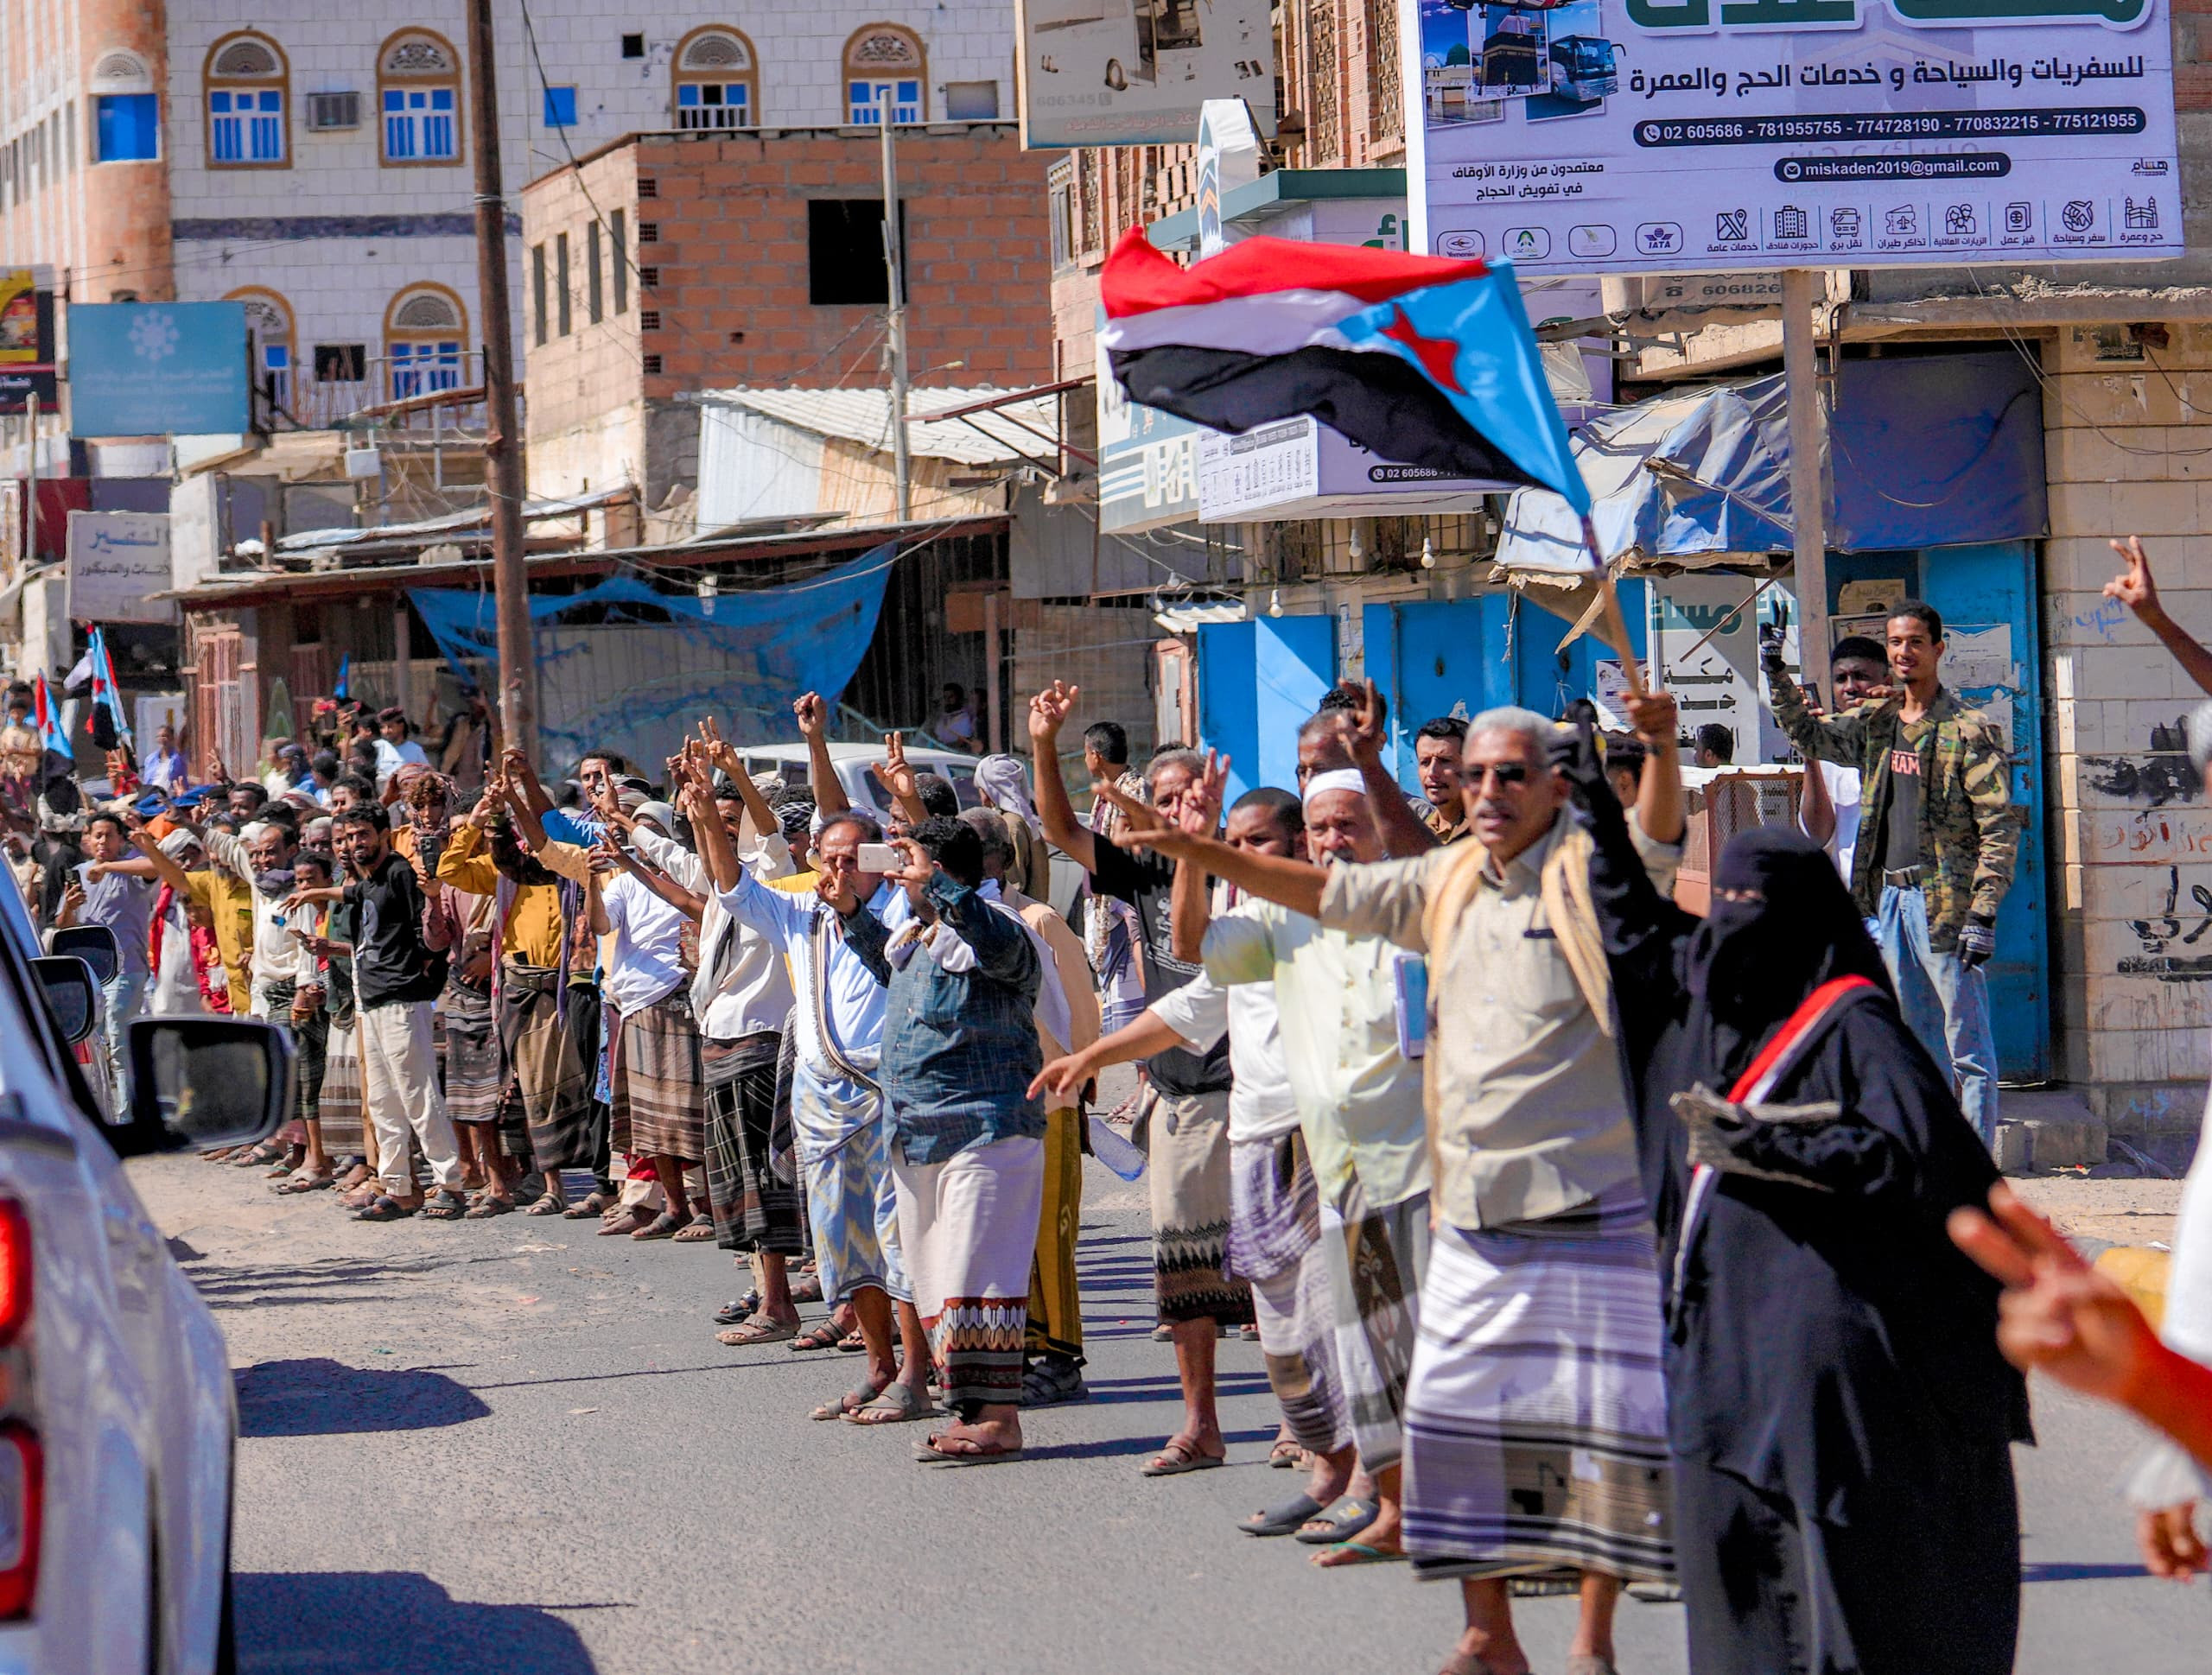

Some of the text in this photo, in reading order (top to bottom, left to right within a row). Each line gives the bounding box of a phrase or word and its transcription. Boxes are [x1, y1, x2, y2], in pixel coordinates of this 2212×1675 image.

[1630, 55, 2144, 99] للسفريات والسياحة و خدمات الحج والعمرة
[1663, 126, 1682, 140] 02
[1687, 124, 1744, 139] 605686
[1758, 121, 1842, 137] 781955755
[1856, 118, 1940, 134] 774728190
[1955, 116, 2038, 131] 770832215
[2052, 113, 2137, 129] 775121955
[1452, 162, 1604, 181] معتمدون من وزارة الأوقاف
[1805, 159, 1999, 176] miskaden2019@gmail.com
[1476, 181, 1583, 201] في تفويض الحجاج
[1877, 238, 1927, 249] تذاكر طيران
[2000, 236, 2019, 246] عمل
[2053, 234, 2106, 244] سفر وسياحة
[2120, 232, 2164, 244] حج وعمرة
[1648, 240, 1671, 249] IATA
[1707, 242, 1758, 252] خدمات عامة
[1765, 241, 1819, 251] حجوزات فنادق
[1829, 239, 1863, 251] نقل بري
[1702, 283, 1782, 295] 606826
[1387, 469, 1400, 479] 02
